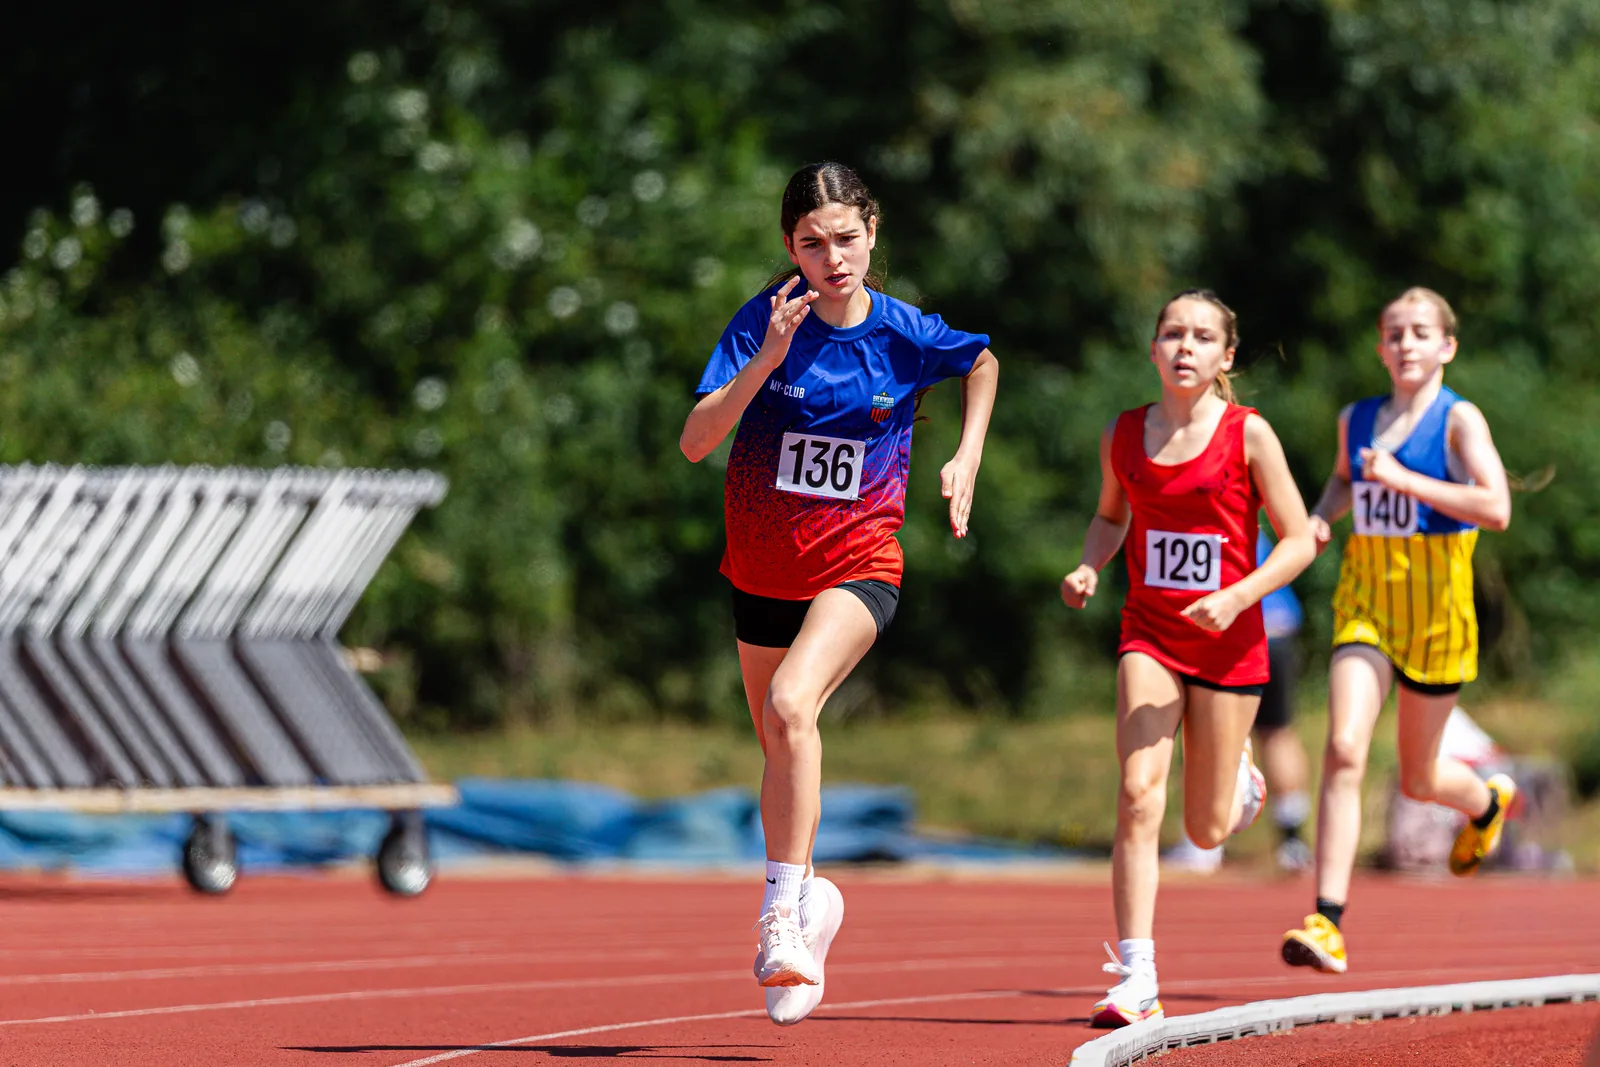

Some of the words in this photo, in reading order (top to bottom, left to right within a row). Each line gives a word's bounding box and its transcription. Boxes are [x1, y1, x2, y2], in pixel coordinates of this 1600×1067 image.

[770, 379, 805, 399] MY-CLUB
[788, 439, 855, 492] 136
[1360, 488, 1410, 529] 140
[1153, 537, 1211, 583] 129
